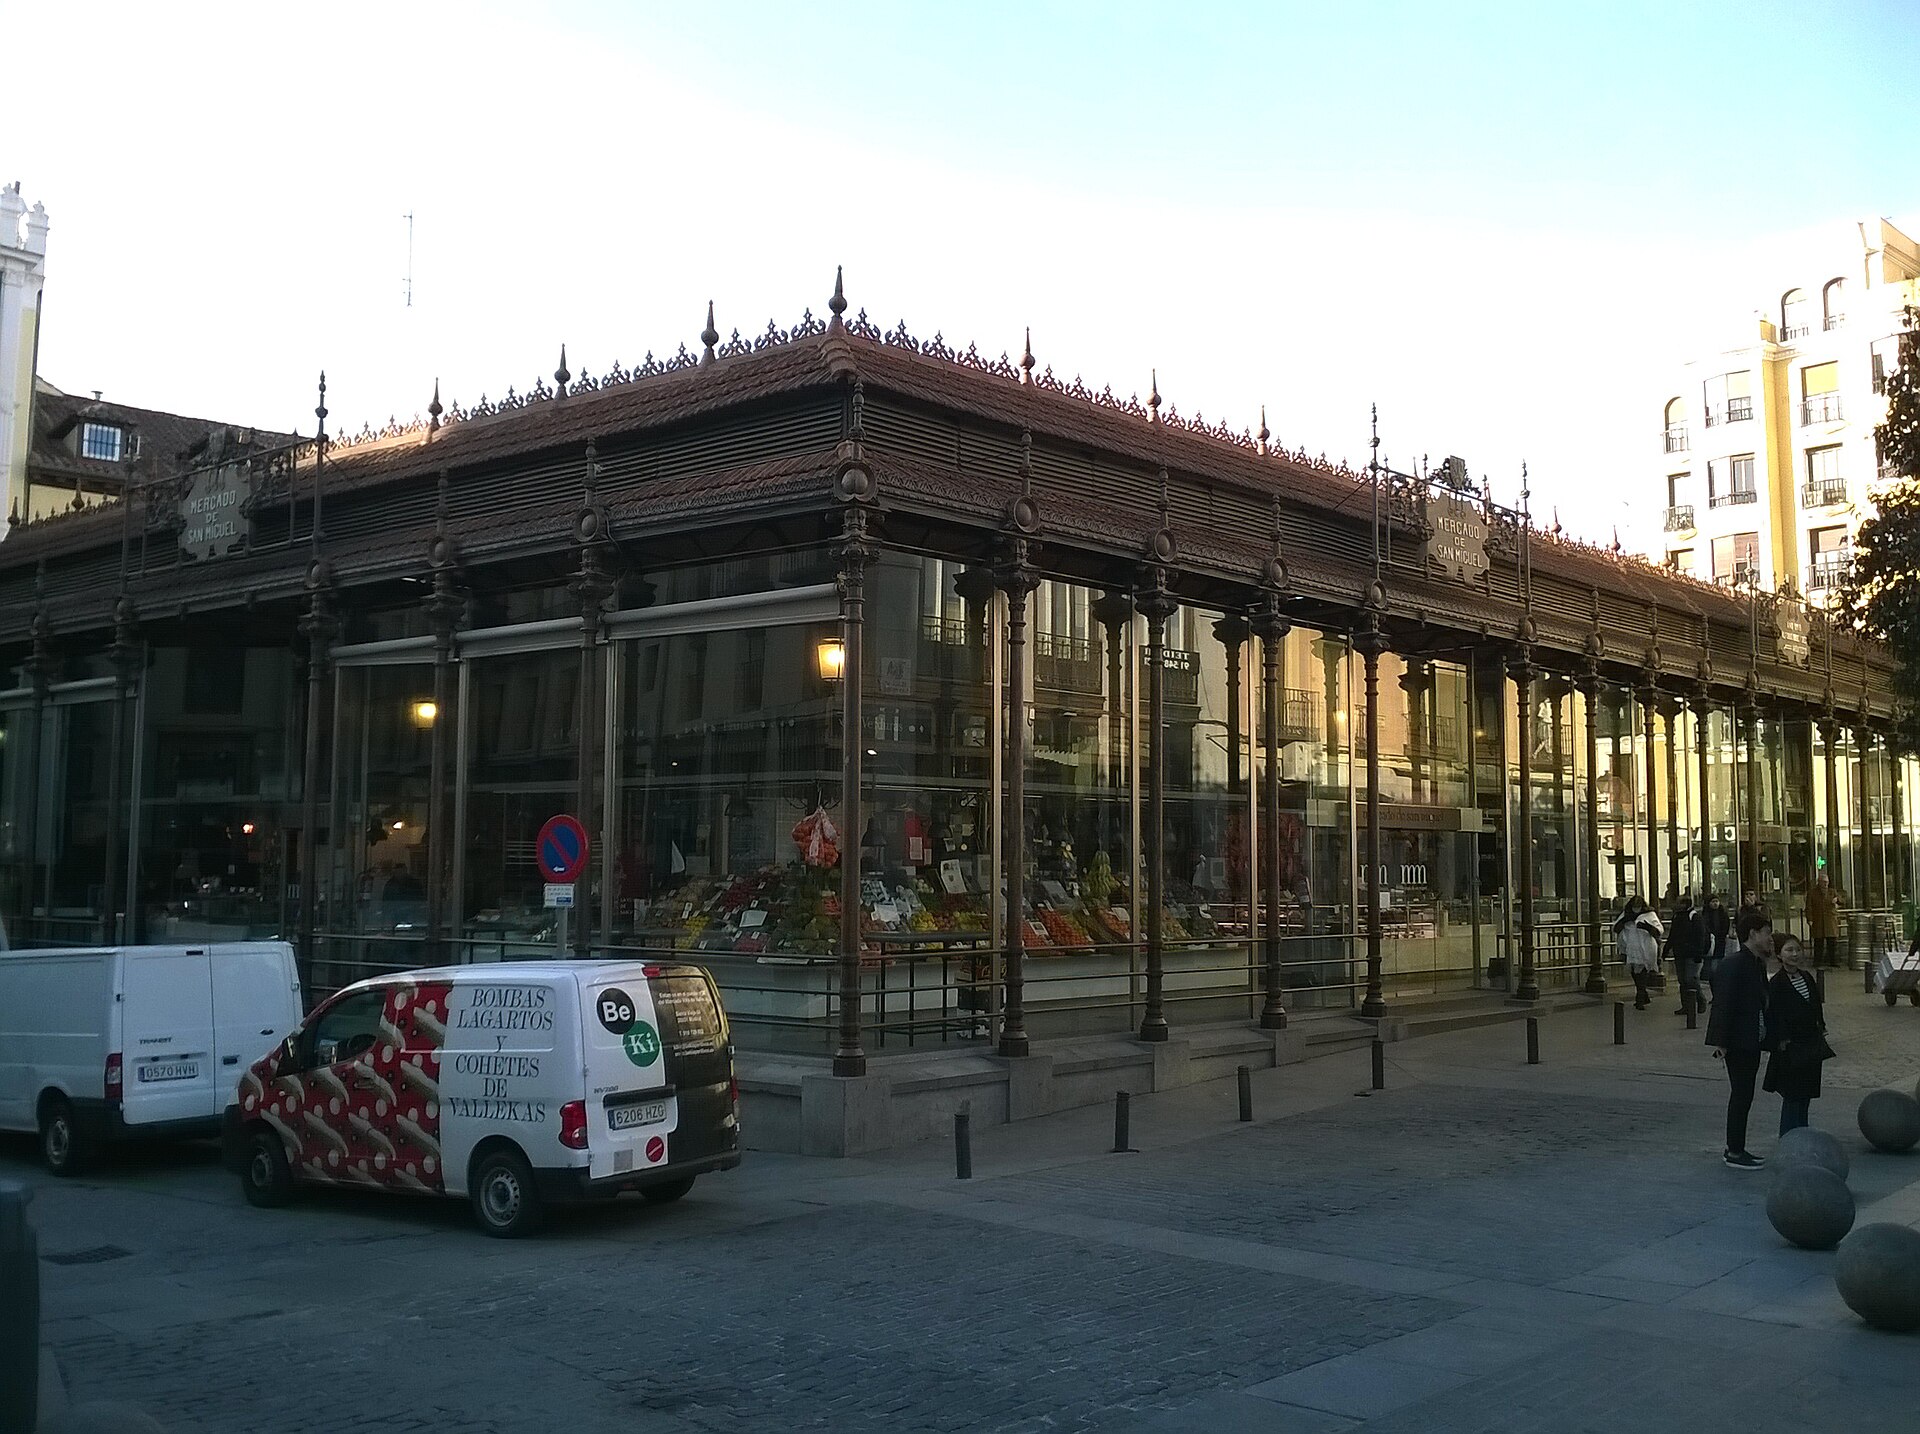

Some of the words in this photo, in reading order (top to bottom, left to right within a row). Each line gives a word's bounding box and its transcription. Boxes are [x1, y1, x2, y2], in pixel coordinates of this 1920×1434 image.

[191, 491, 236, 514] MERCADO
[206, 512, 218, 523] DE
[1437, 516, 1480, 539] MERCADO
[188, 527, 203, 544] SAN
[205, 521, 236, 541] MIGUEL
[1454, 536, 1466, 547] DE
[1437, 544, 1454, 562] SAN
[1455, 546, 1483, 568] MIGUEL
[471, 987, 547, 1008] BOMBAS
[456, 1010, 554, 1031] LAGARTOS
[602, 1001, 631, 1023] Be
[628, 1033, 656, 1056] Ki
[146, 1066, 173, 1078] 0570
[176, 1065, 195, 1076] HVH
[455, 1056, 540, 1078] COHETES
[483, 1078, 508, 1098] DE
[448, 1097, 546, 1123] VALLEKAS
[616, 1109, 643, 1124] 6206
[646, 1104, 665, 1119] HZG
